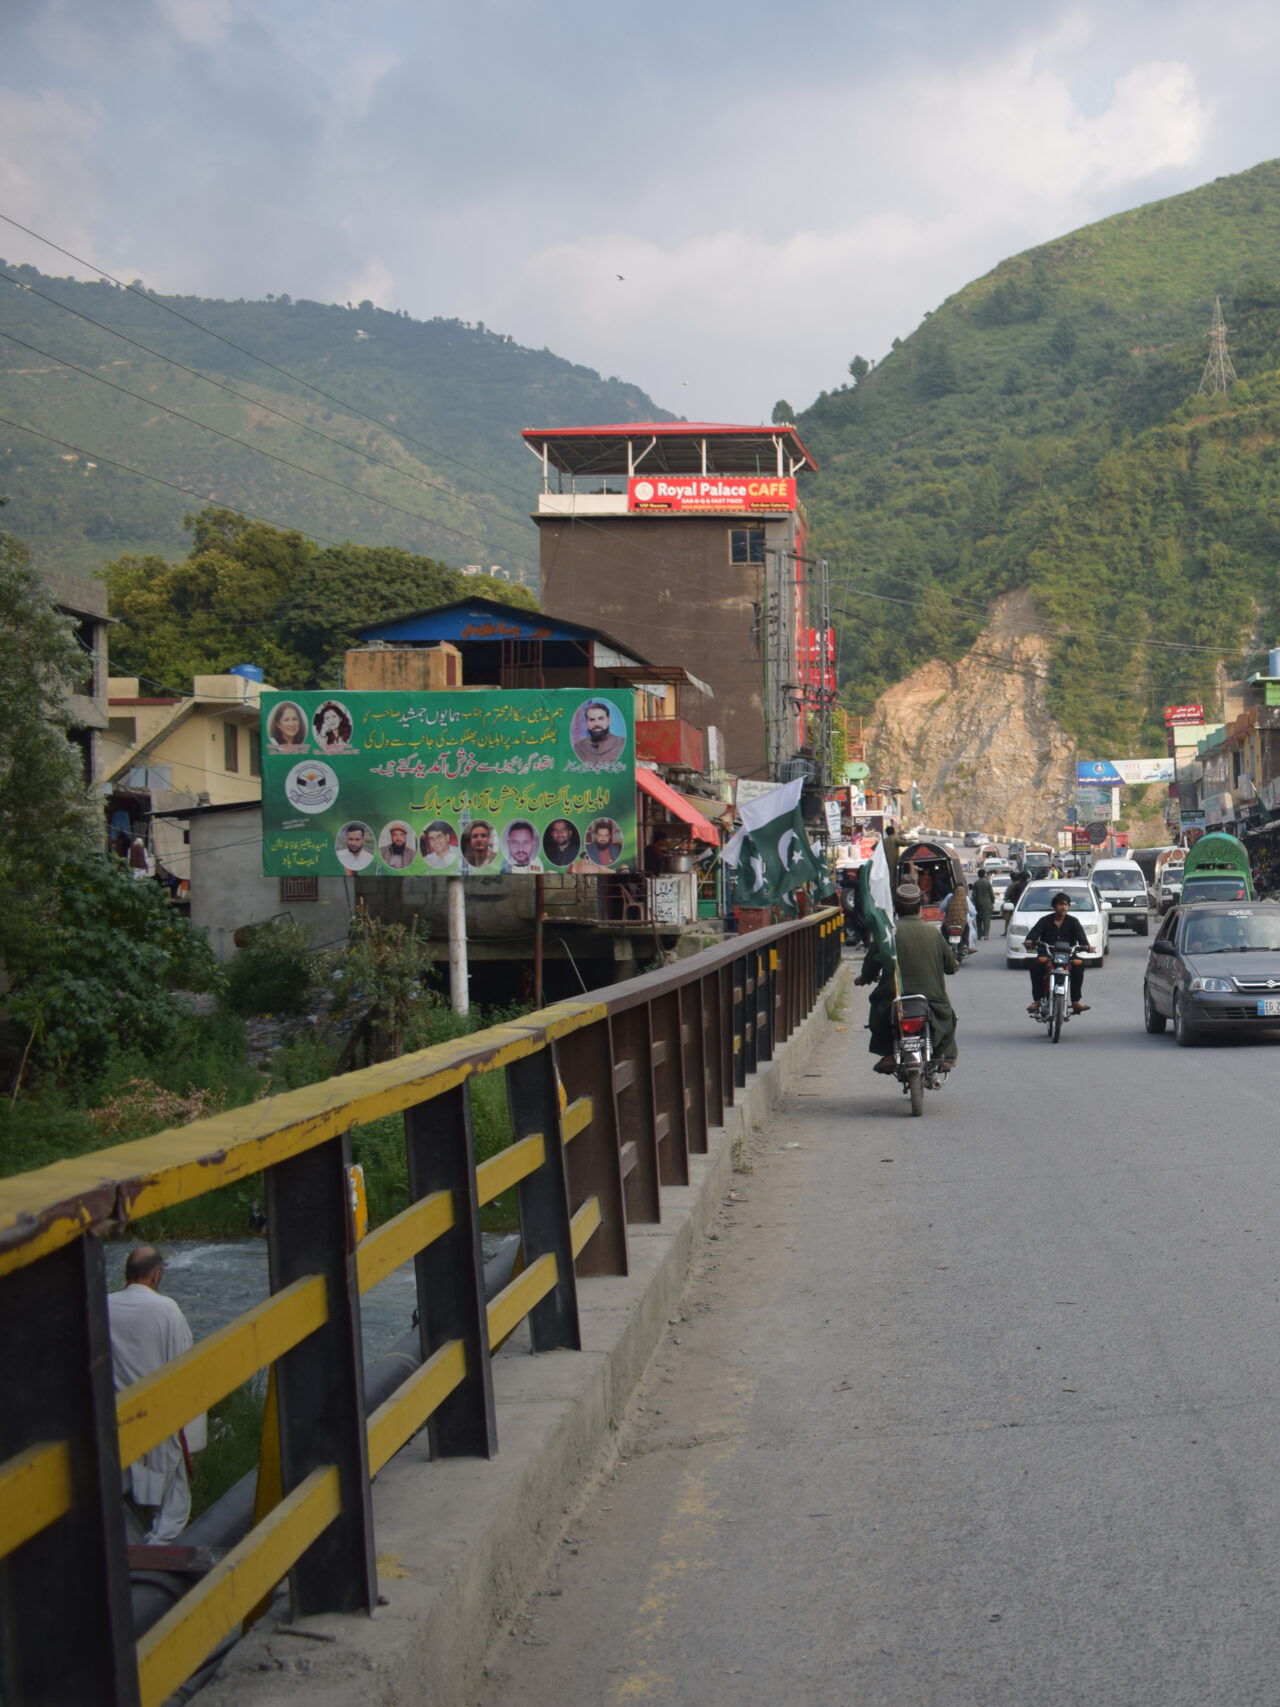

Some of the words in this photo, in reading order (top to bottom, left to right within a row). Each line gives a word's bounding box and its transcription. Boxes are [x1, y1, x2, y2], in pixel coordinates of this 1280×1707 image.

[658, 481, 697, 500] Royal
[701, 481, 747, 497] Palace
[748, 479, 788, 497] CAFÉ
[397, 706, 428, 728] جمشید
[425, 707, 461, 727] ہمایوں
[409, 784, 452, 817] مبارک
[527, 784, 573, 815] پاکستان
